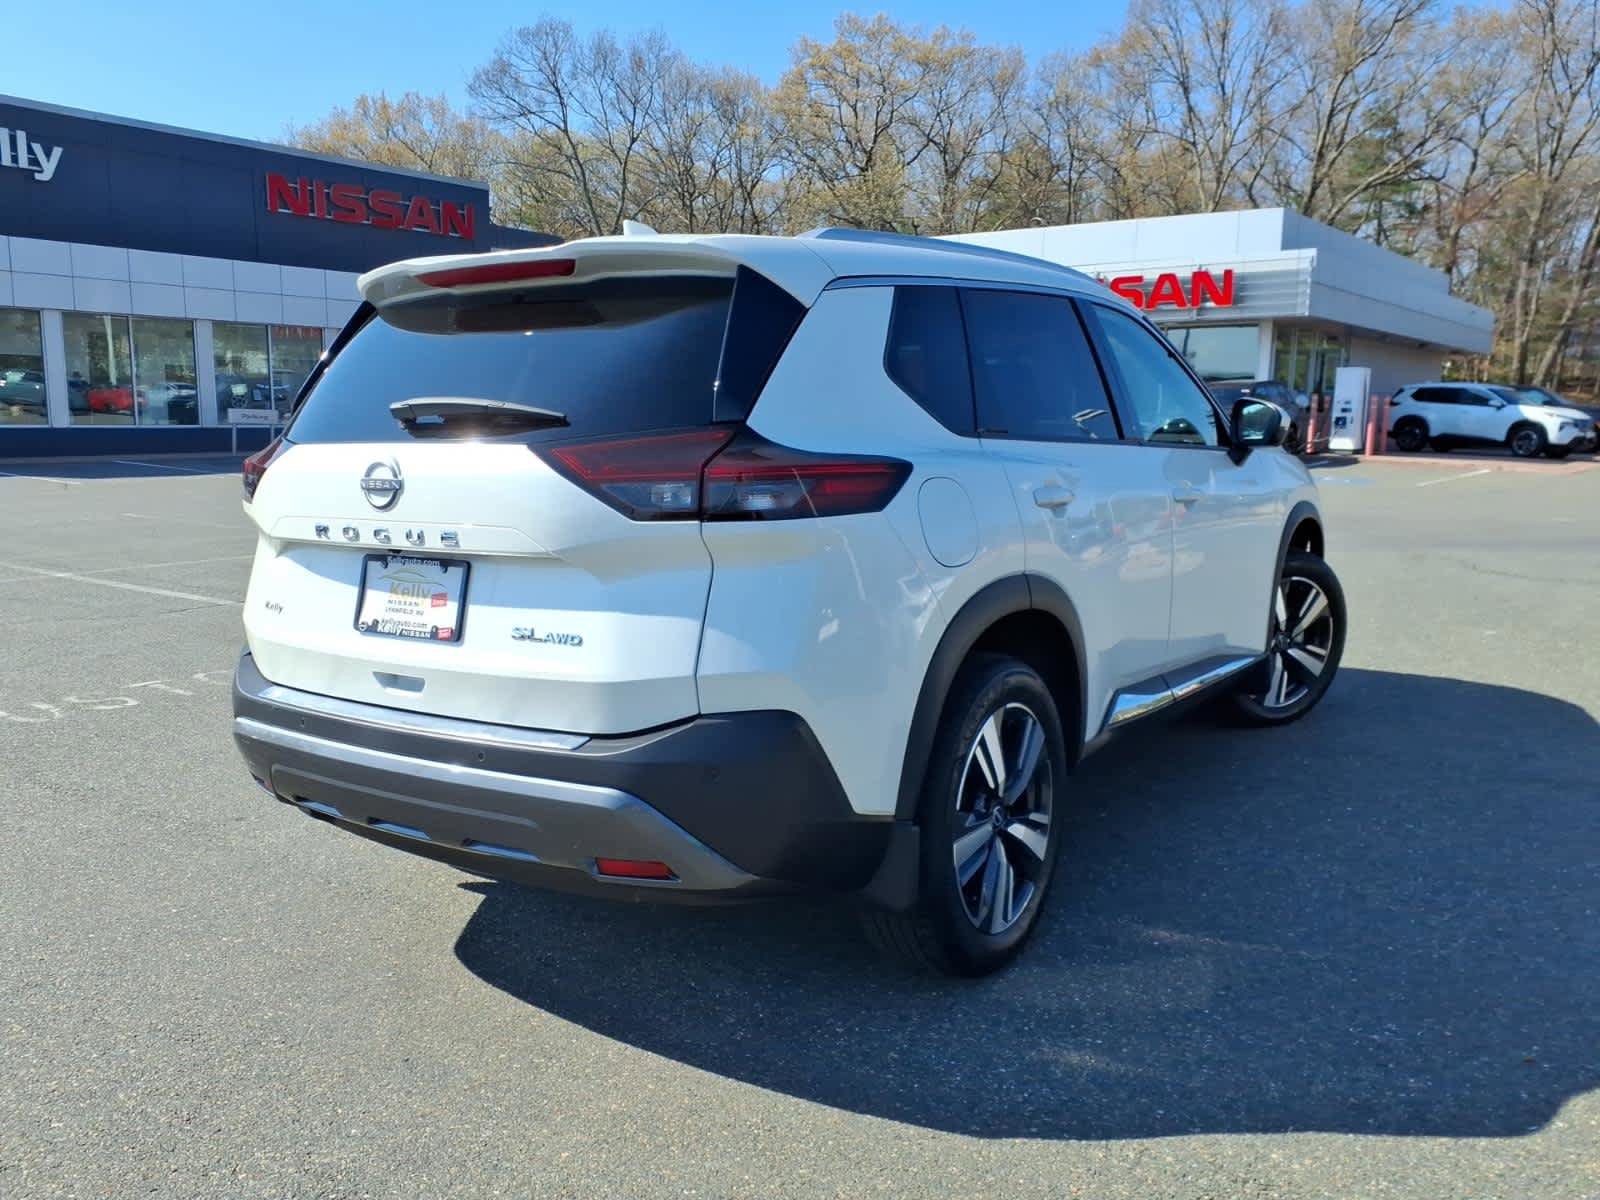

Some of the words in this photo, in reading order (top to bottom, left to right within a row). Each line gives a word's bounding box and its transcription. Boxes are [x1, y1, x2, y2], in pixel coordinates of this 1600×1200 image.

[266, 171, 475, 240] NISSAN
[360, 478, 402, 492] NISSAN
[315, 524, 460, 547] ROGUE
[391, 582, 430, 599] Kelly
[265, 601, 284, 615] Kelly
[377, 623, 402, 636] Kelly
[402, 629, 430, 638] NISSAN
[511, 627, 543, 642] SL
[543, 632, 584, 647] AWD
